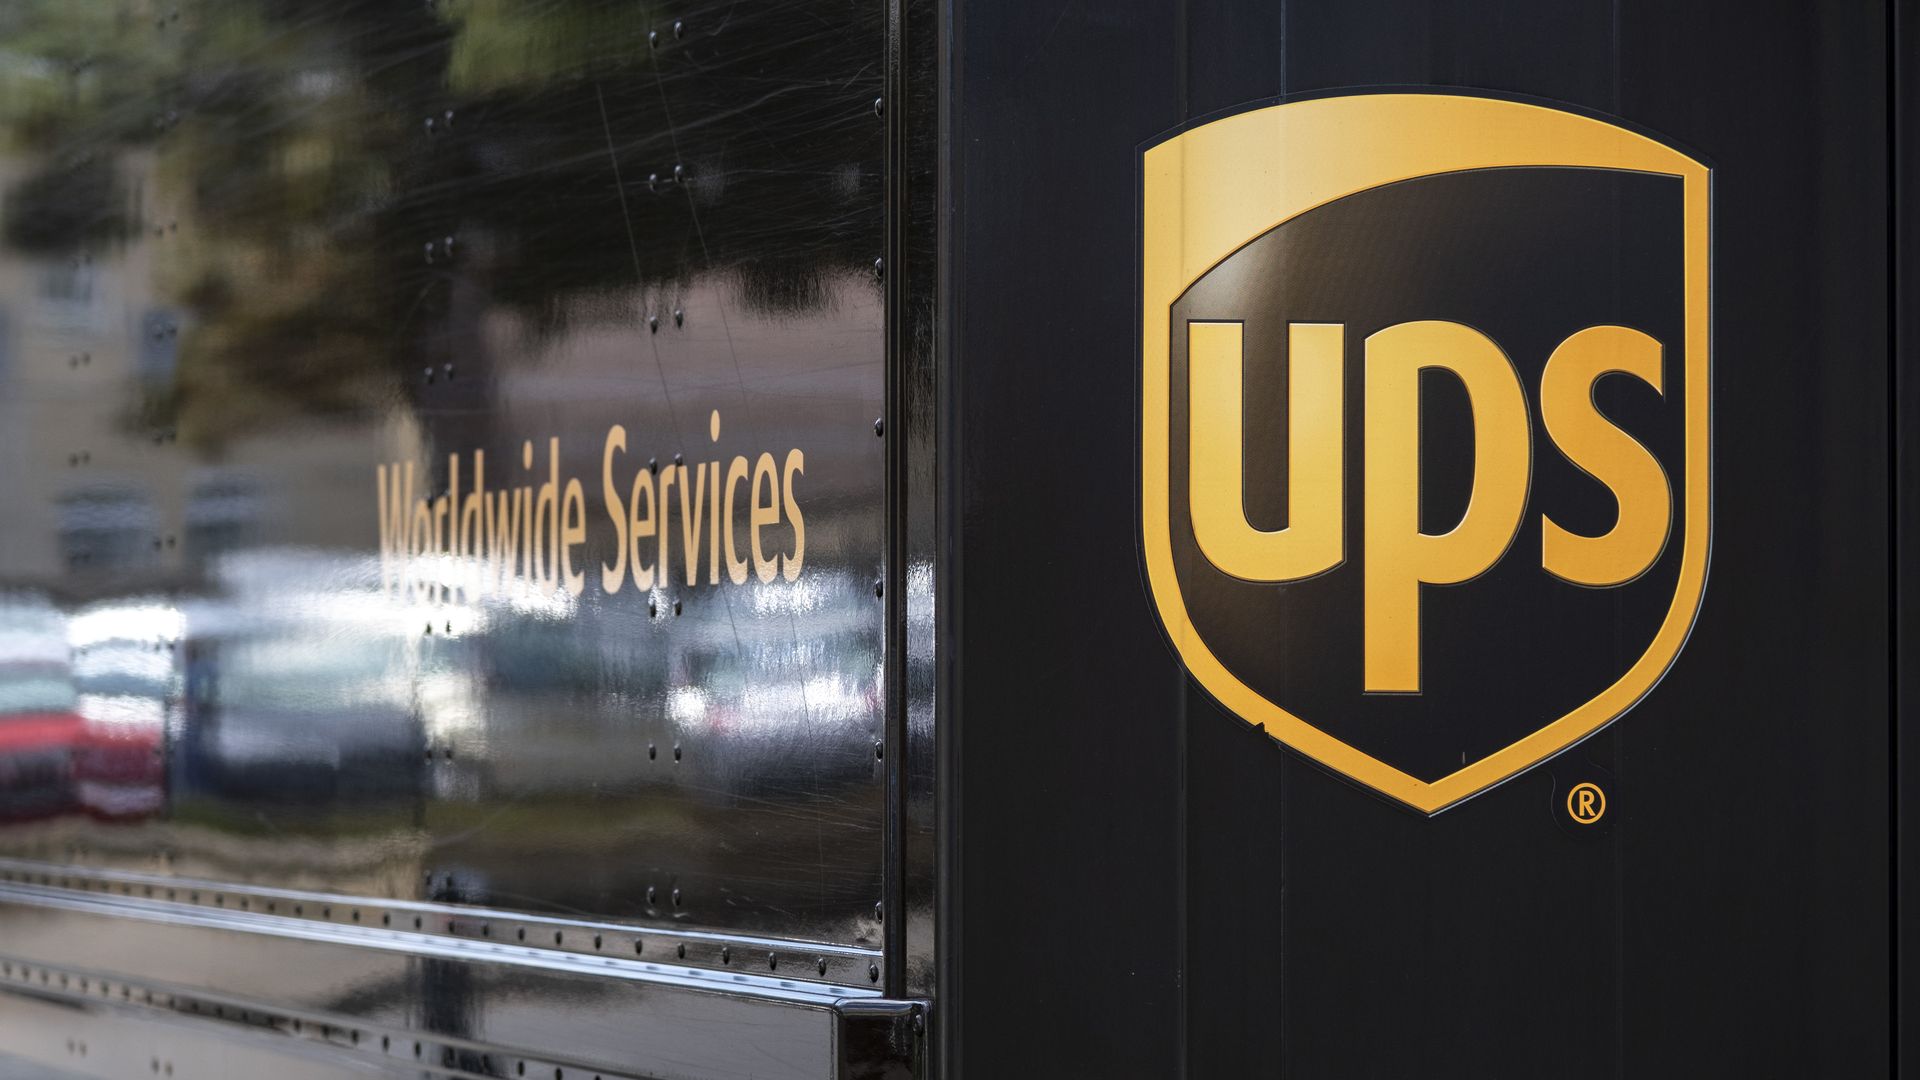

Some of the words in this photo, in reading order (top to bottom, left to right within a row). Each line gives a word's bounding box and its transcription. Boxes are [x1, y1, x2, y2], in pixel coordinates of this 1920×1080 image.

[377, 437, 587, 602] Worldwide
[602, 409, 805, 595] Services
[1187, 320, 1672, 692] ups
